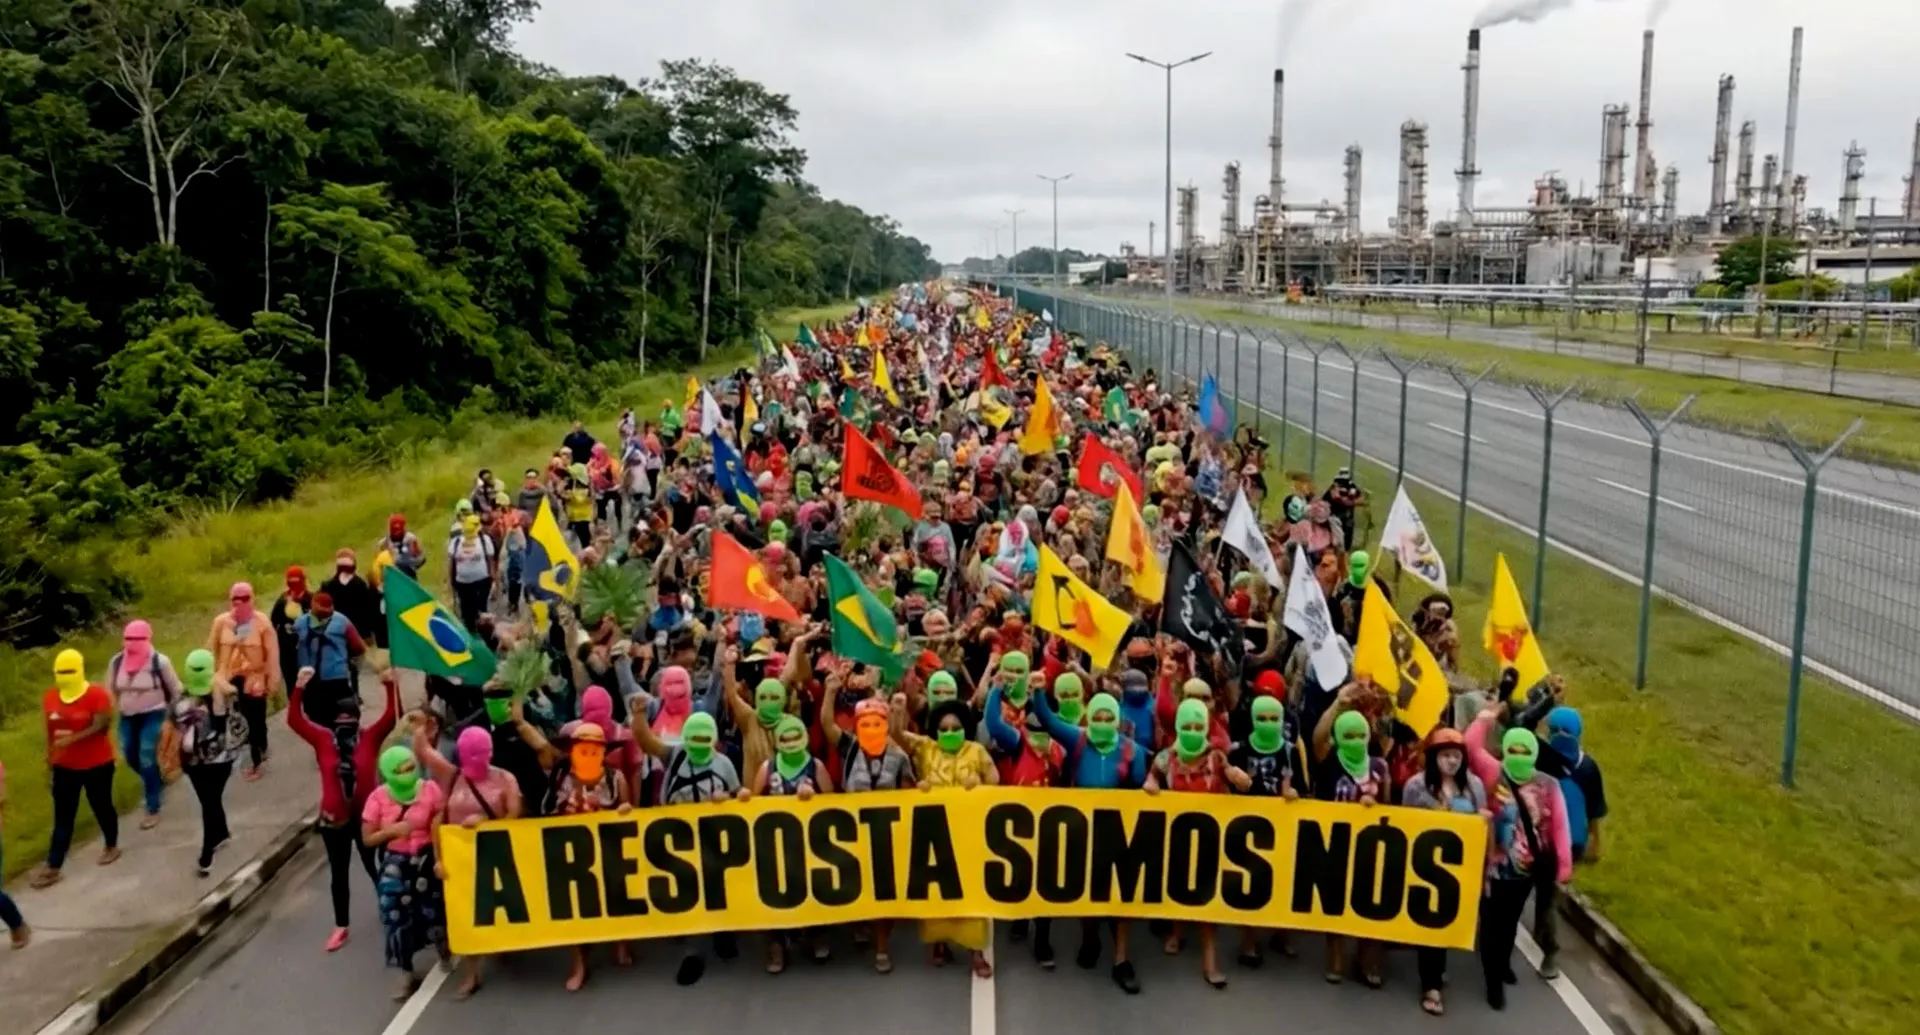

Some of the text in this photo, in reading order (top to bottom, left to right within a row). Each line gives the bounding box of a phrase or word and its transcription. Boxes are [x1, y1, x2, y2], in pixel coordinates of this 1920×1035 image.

[474, 803, 1464, 930] A RESPOSTA SOMOS NÓS
